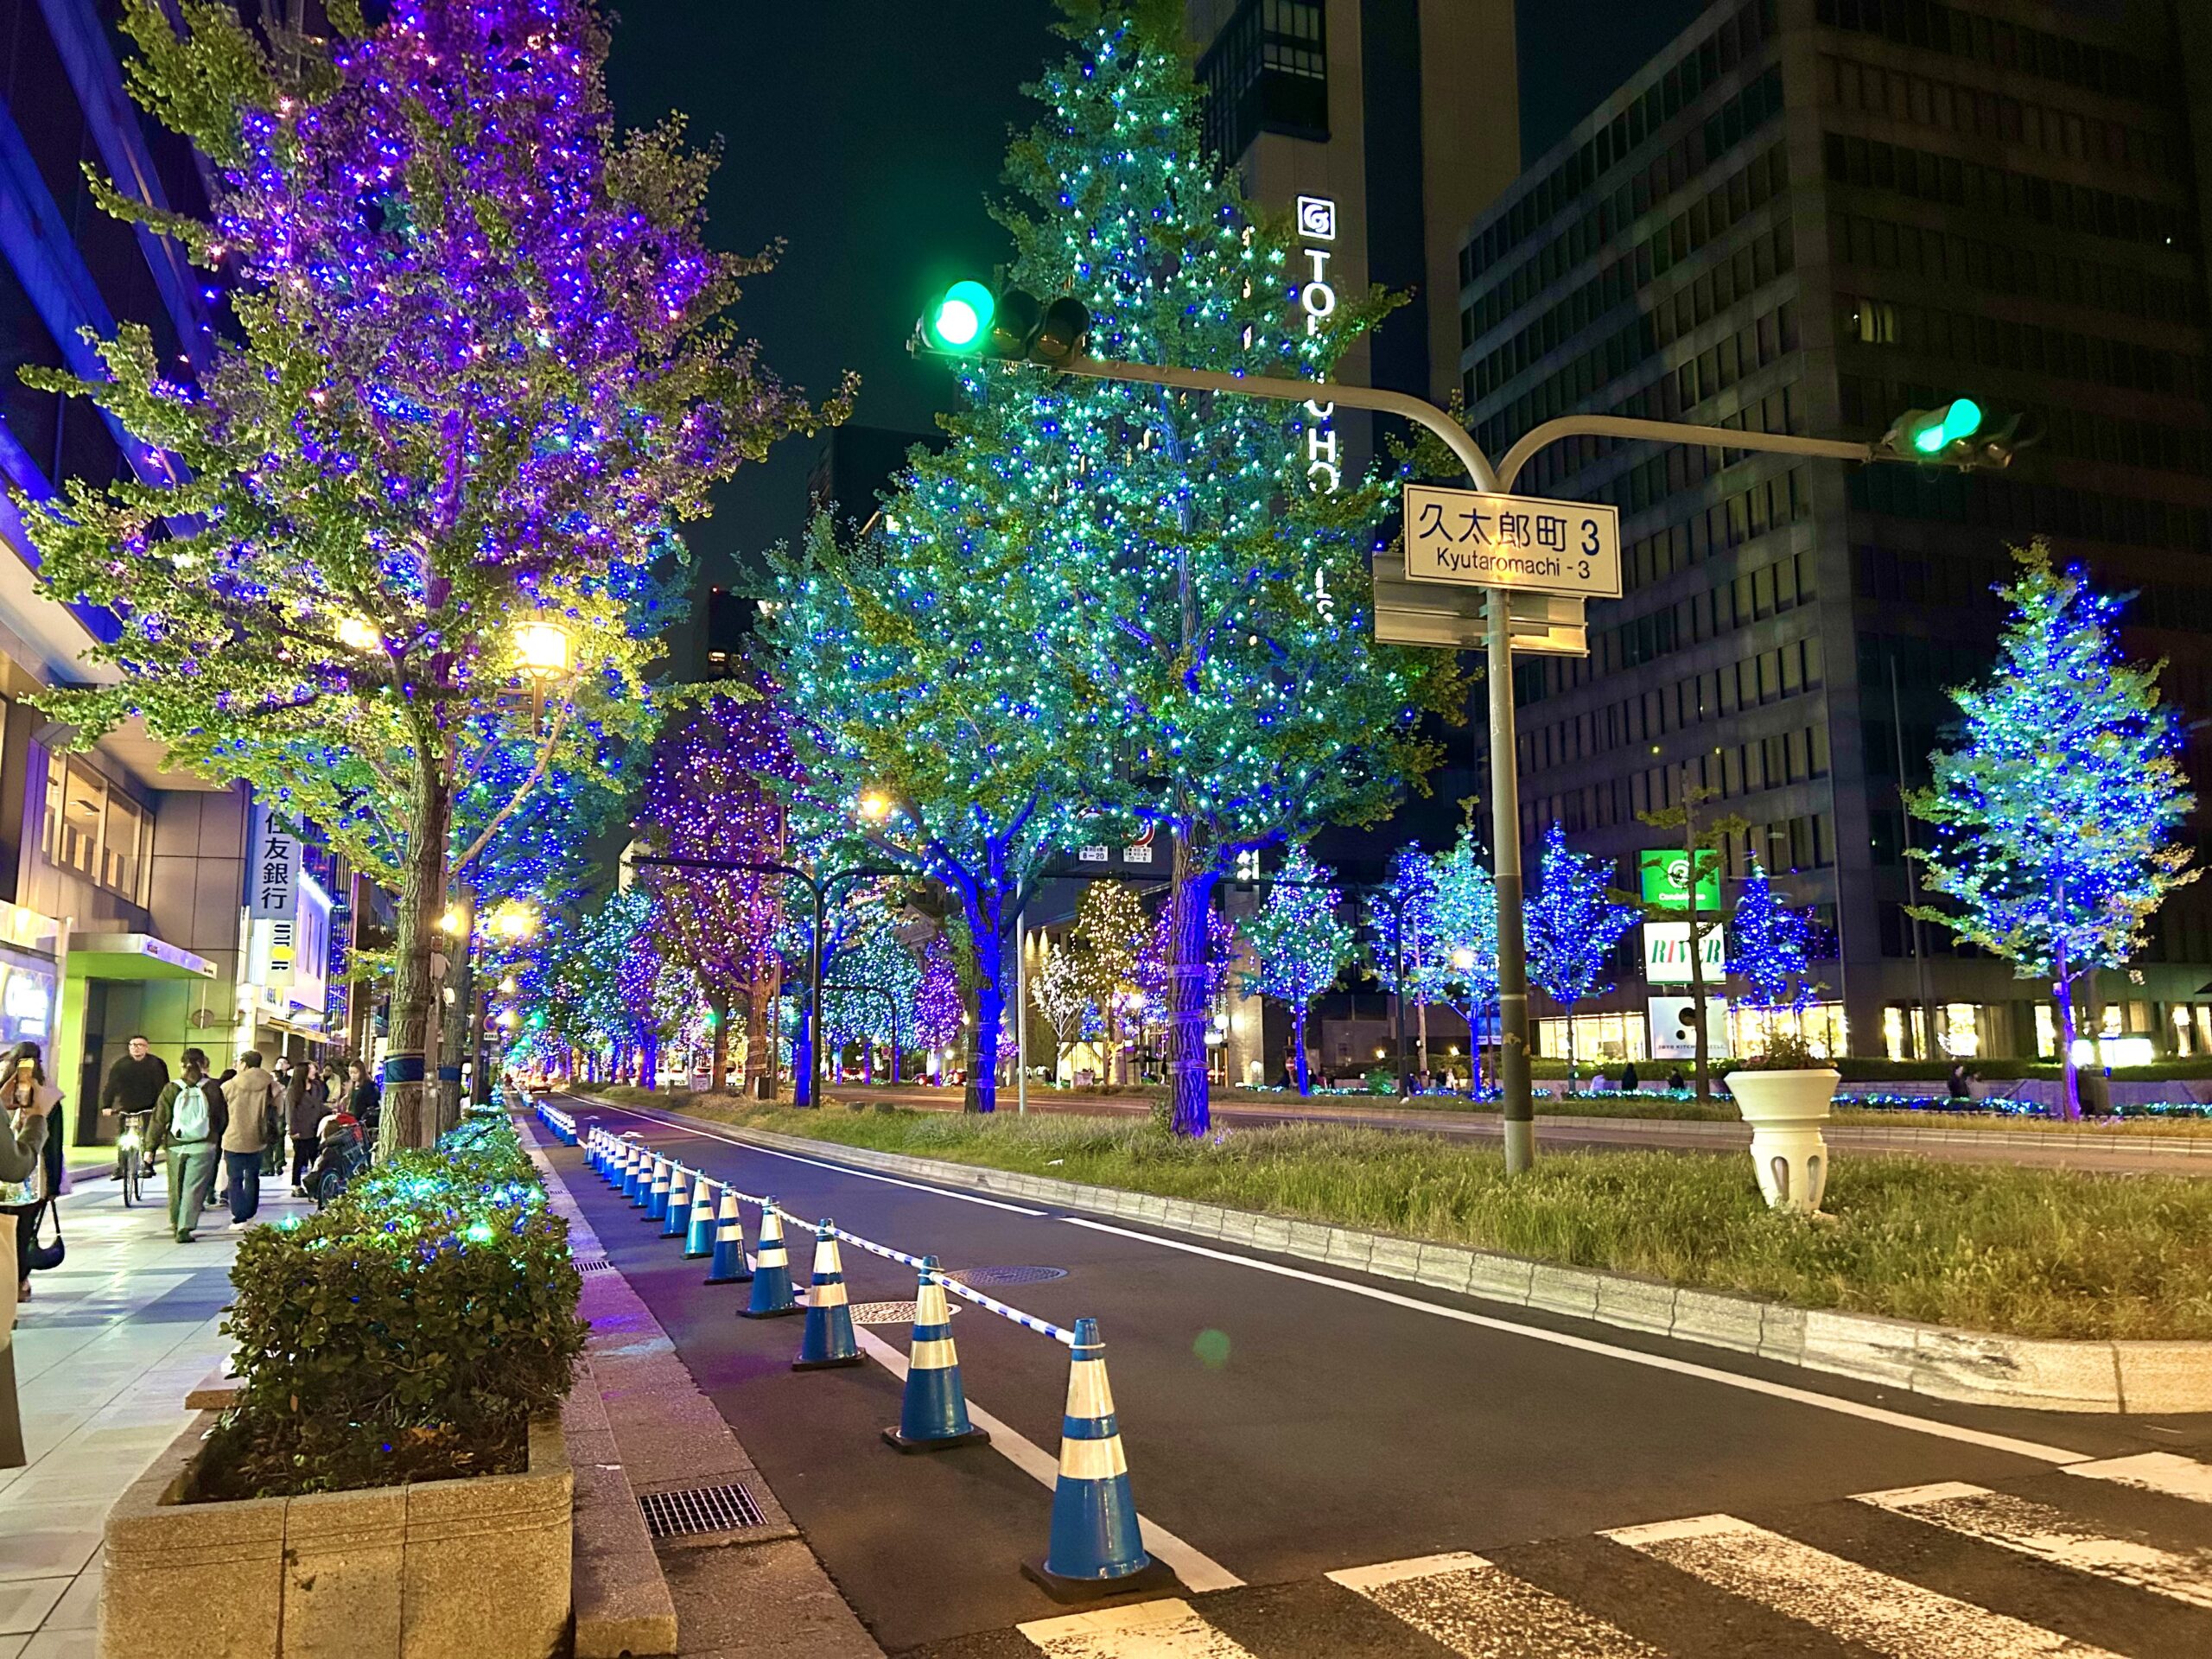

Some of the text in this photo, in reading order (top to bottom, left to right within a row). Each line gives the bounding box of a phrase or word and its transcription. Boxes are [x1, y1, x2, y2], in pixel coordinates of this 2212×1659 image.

[1419, 503, 1600, 556] 久太郎町 3
[1437, 546, 1560, 576] Kyutaromachi
[1651, 939, 1721, 963] RIVR
